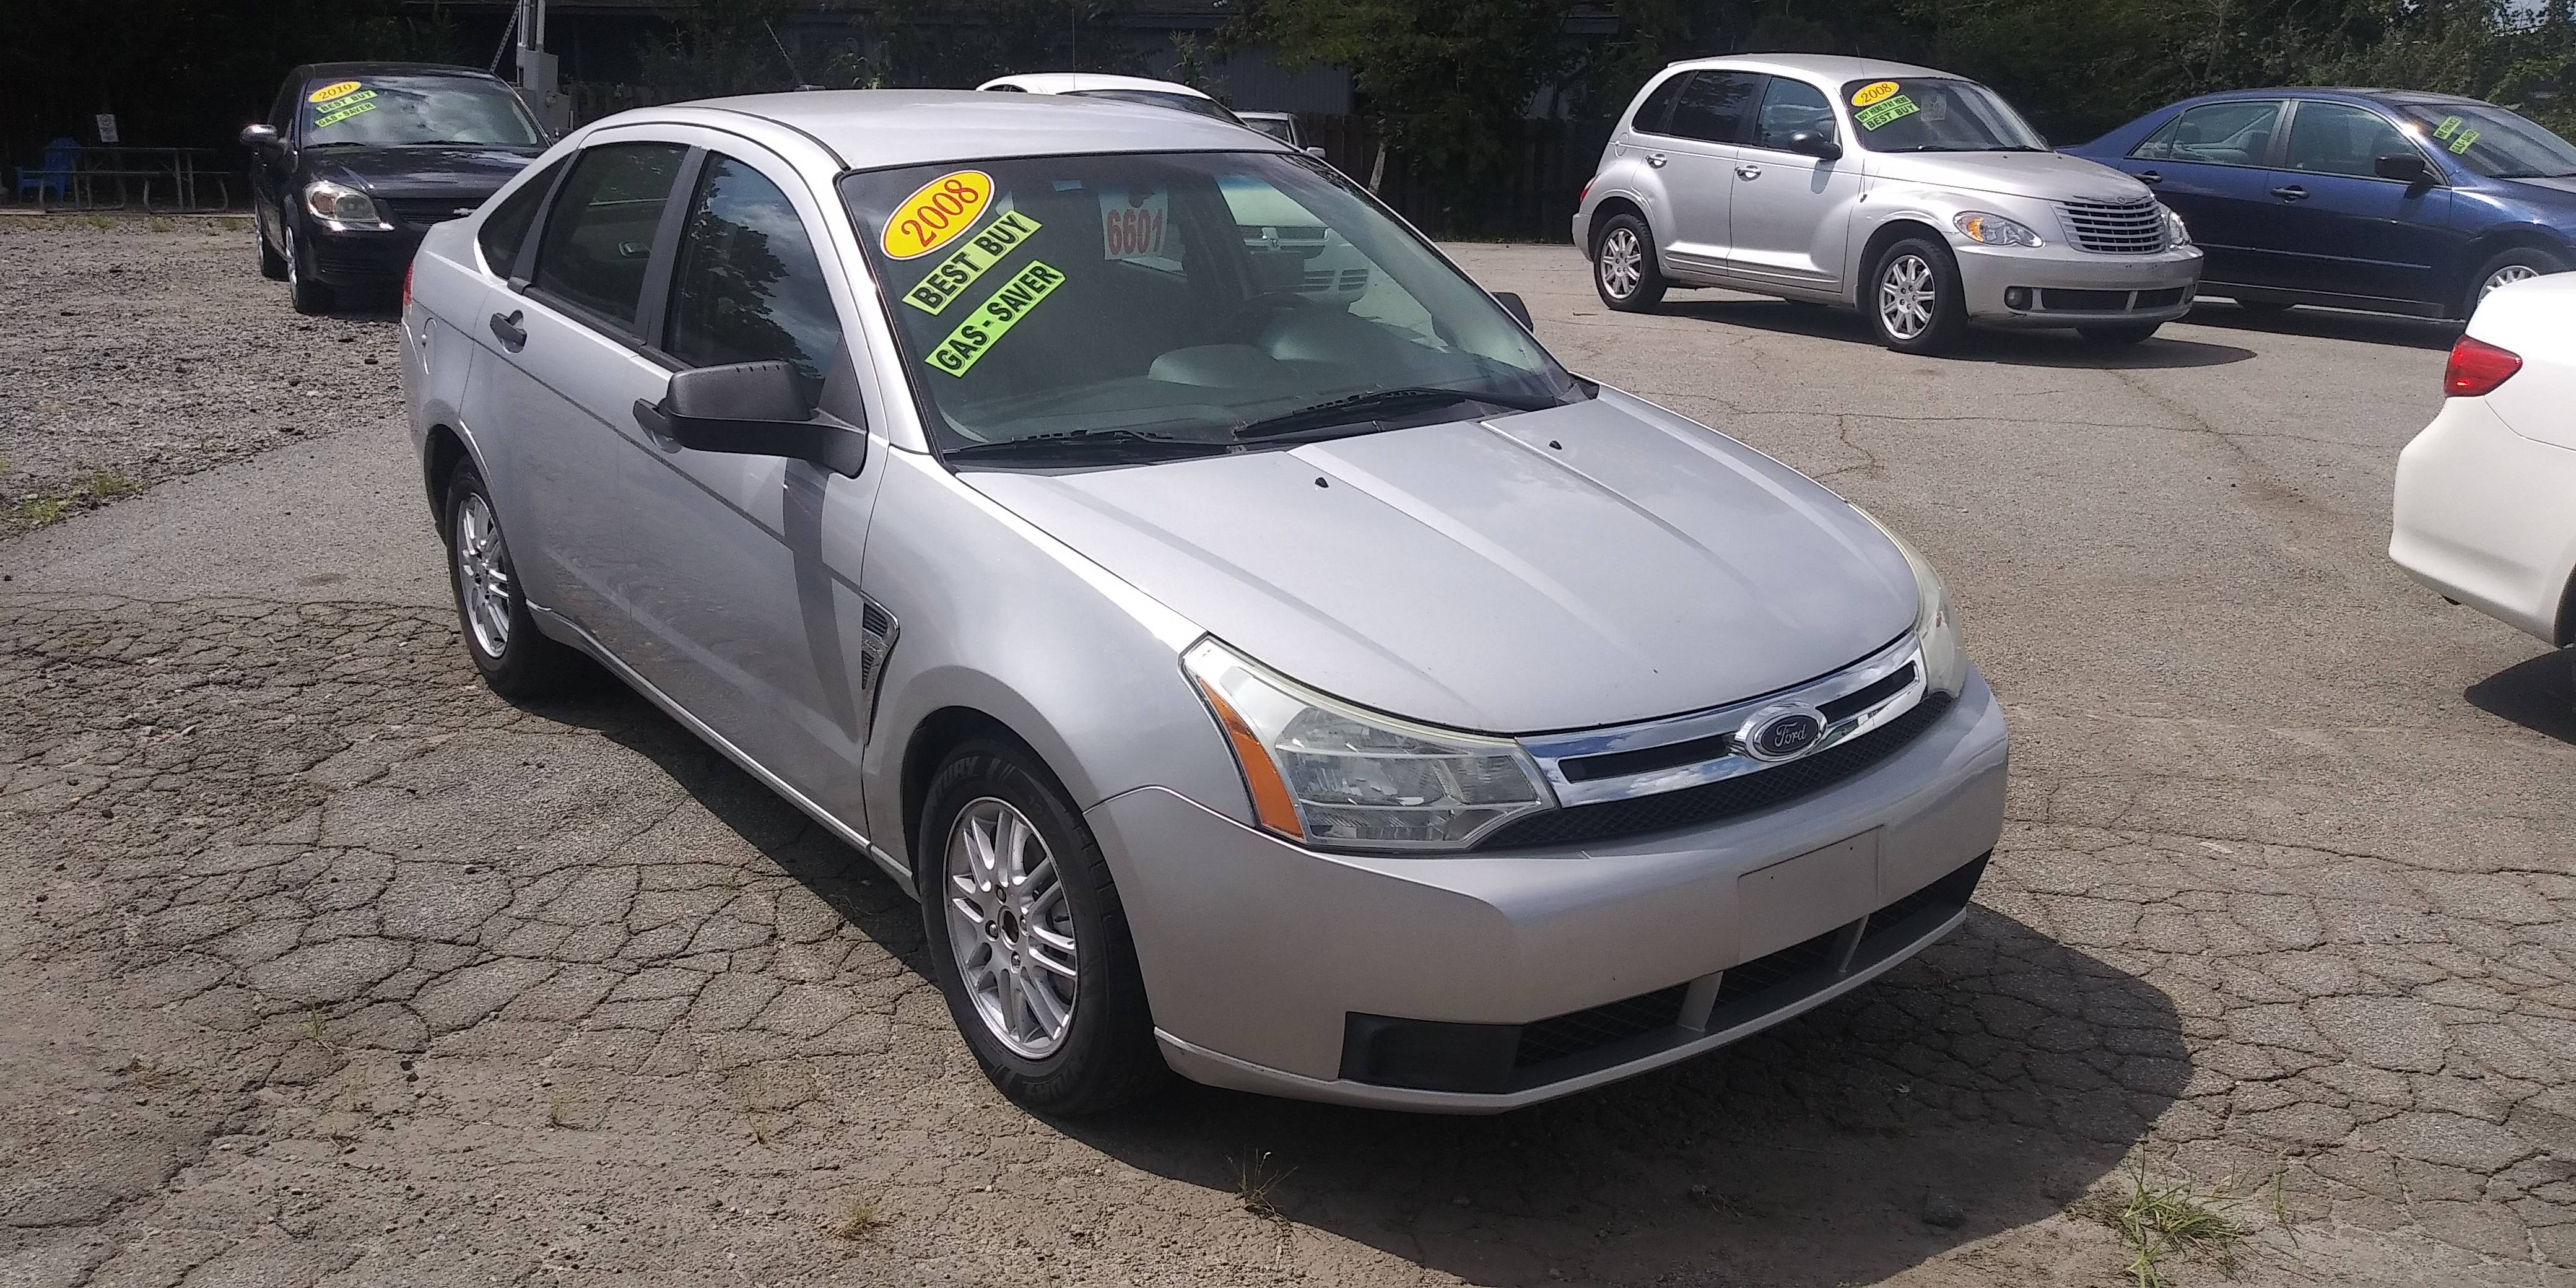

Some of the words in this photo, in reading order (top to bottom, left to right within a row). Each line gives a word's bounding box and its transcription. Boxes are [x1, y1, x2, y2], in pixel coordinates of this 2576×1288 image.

[319, 84, 352, 99] 2010
[321, 99, 347, 111] BEST
[350, 92, 372, 101] BUY
[1861, 83, 1892, 103] 2008
[1857, 110, 1871, 121] BUY
[1866, 113, 1892, 128] BEST
[1895, 104, 1915, 116] BUY
[901, 179, 979, 248] 2008
[1107, 208, 1163, 256] 6601
[910, 251, 983, 310] BEST
[973, 214, 1032, 256] BUY
[1774, 721, 1807, 747] Ford
